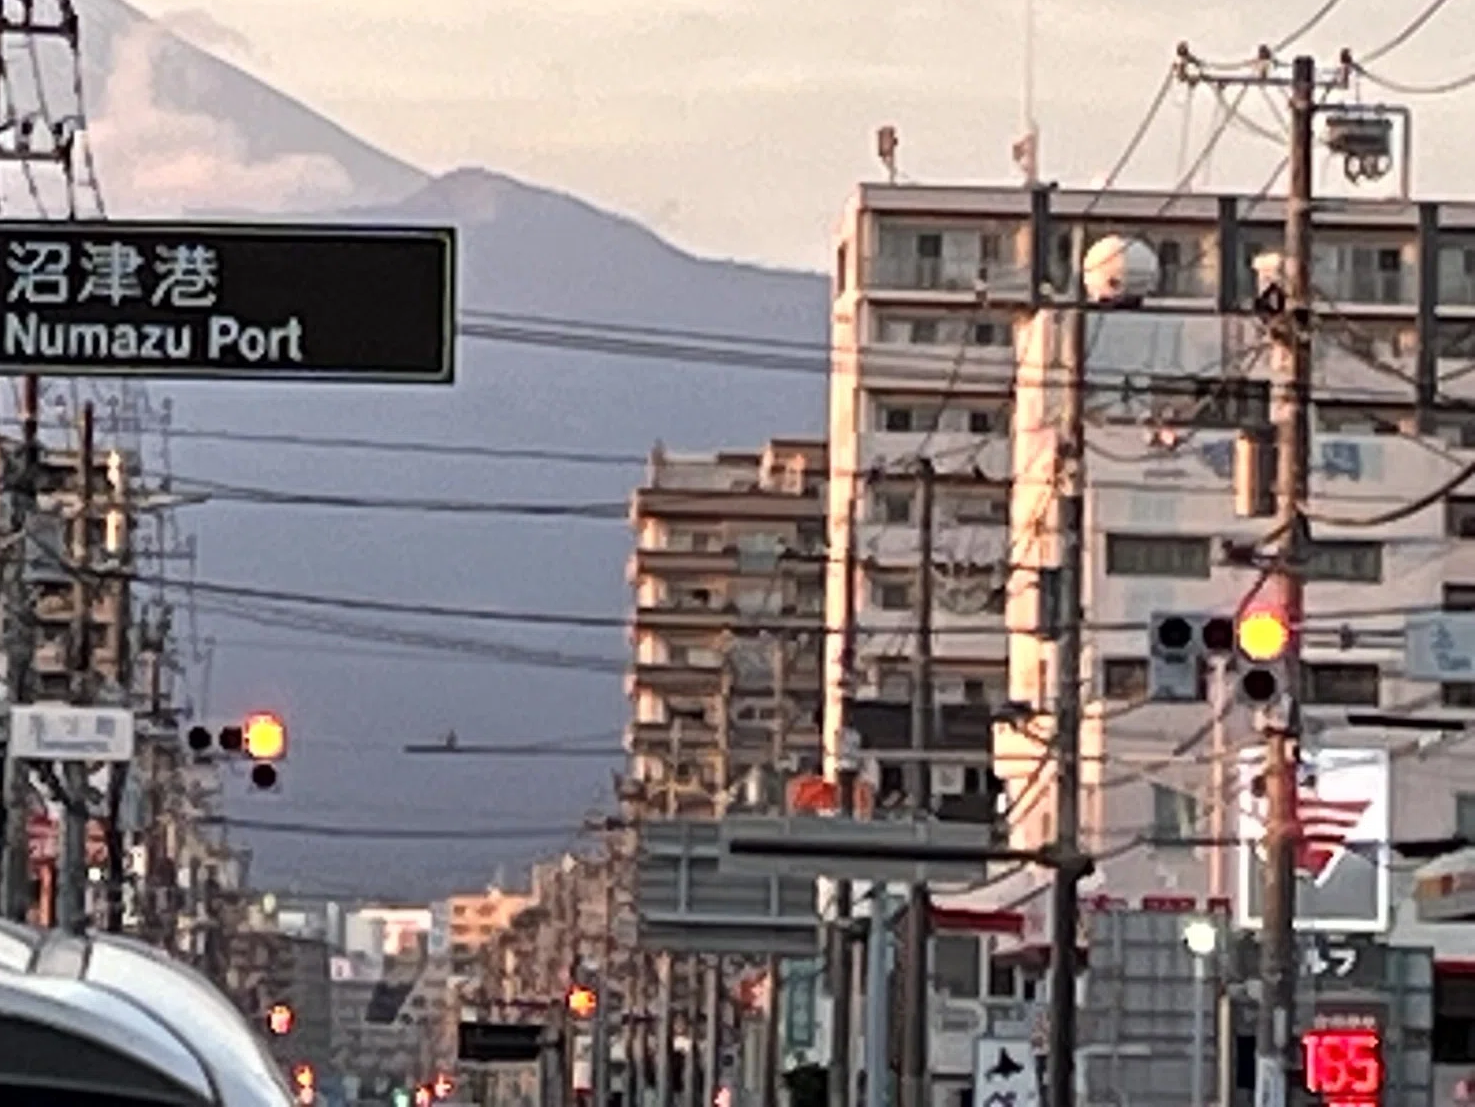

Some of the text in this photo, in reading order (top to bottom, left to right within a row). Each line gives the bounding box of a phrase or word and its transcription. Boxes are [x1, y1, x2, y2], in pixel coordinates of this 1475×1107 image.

[4, 240, 219, 308] 沼津港
[2, 311, 193, 360] Numazu
[207, 314, 304, 363] Port
